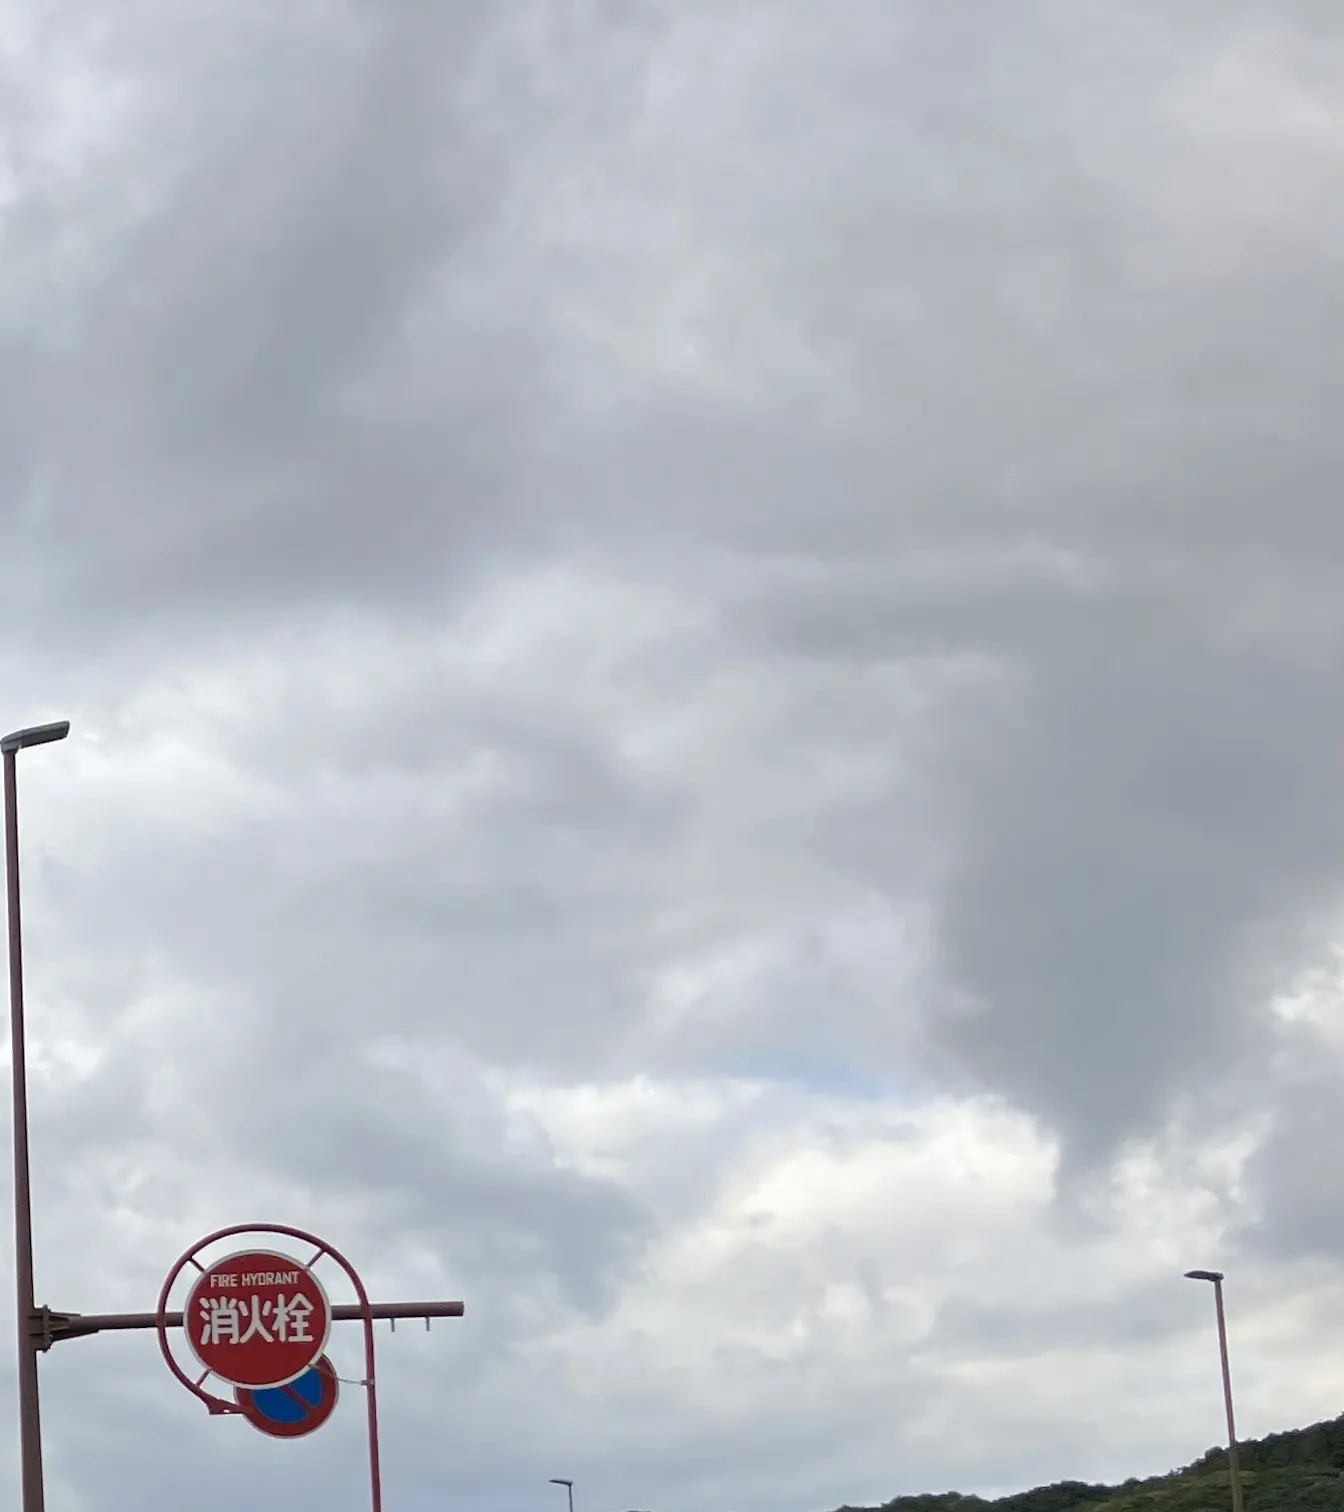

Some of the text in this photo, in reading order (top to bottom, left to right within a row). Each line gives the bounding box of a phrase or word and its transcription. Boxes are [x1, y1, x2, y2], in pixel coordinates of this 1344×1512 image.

[210, 1271, 301, 1288] FIRE HYDRANT
[199, 1292, 314, 1346] 消火栓
